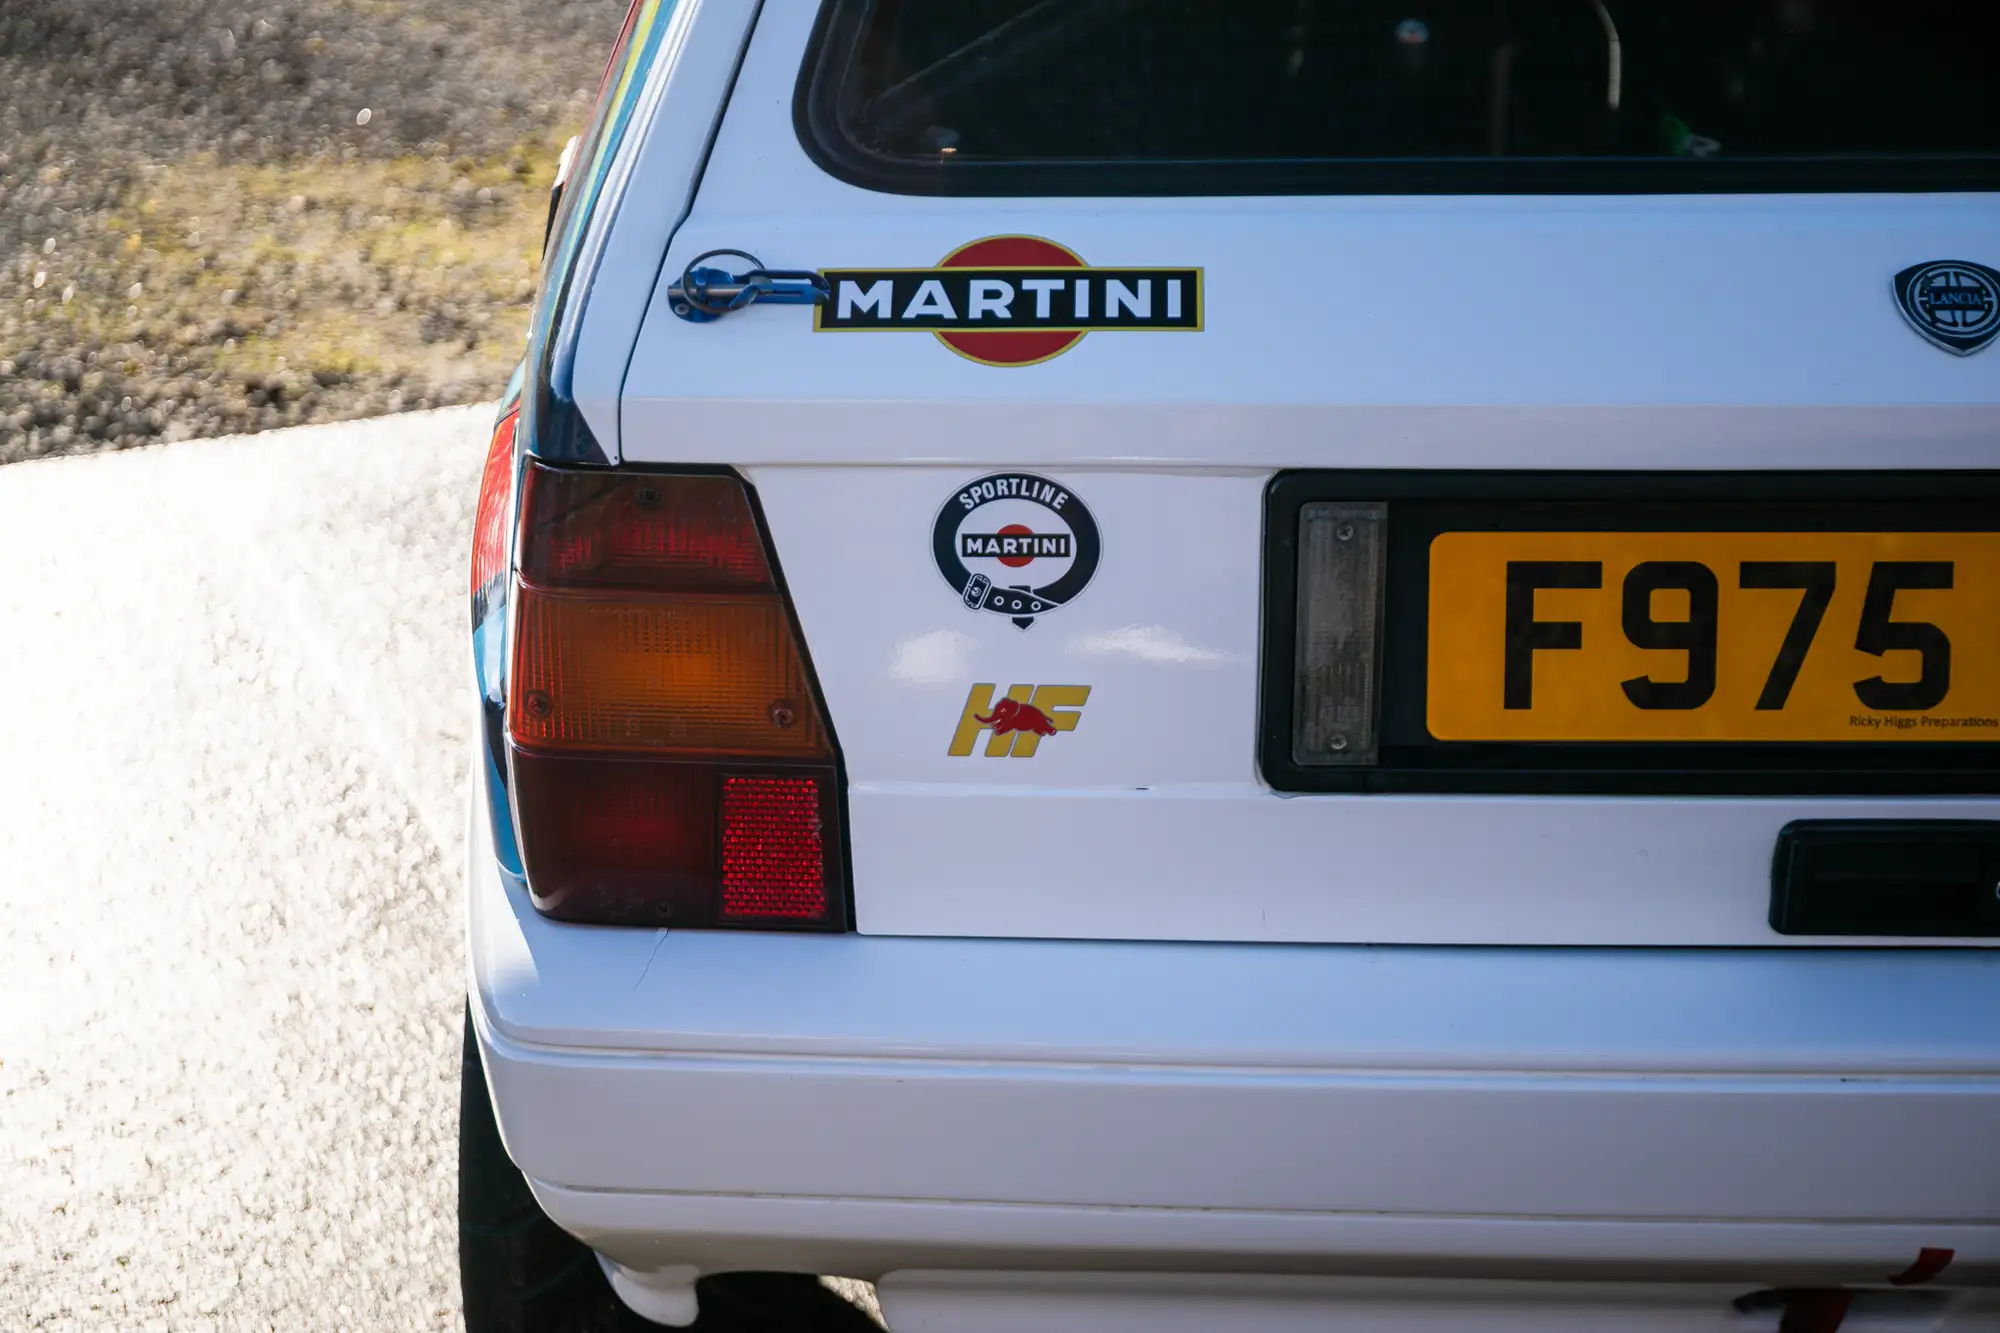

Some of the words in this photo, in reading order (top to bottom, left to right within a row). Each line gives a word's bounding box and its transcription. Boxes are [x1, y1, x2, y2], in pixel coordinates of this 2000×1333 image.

[837, 279, 1182, 318] MARTINI
[1929, 291, 1982, 305] LANCIA
[959, 478, 1068, 510] SPORTLINE
[966, 538, 1065, 554] MARTINI
[1503, 560, 1955, 711] F975
[947, 683, 1092, 758] HF
[1849, 715, 1881, 729] Ricky
[1884, 715, 1918, 729] Higgs
[1921, 715, 1999, 729] Preparations
